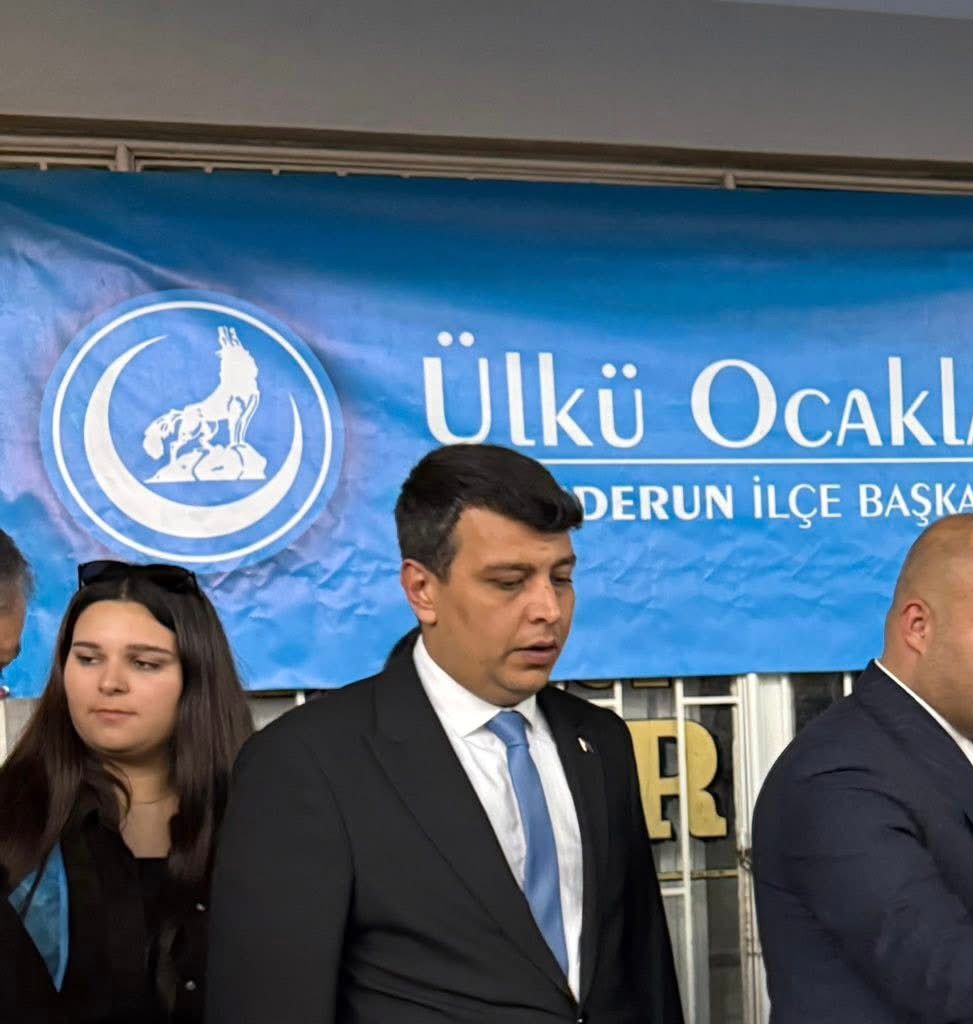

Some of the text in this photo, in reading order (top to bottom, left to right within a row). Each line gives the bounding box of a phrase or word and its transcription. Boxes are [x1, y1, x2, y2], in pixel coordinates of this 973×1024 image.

[572, 484, 734, 521] DERUN
[752, 475, 842, 529] İLÇE
[627, 719, 728, 839] R
